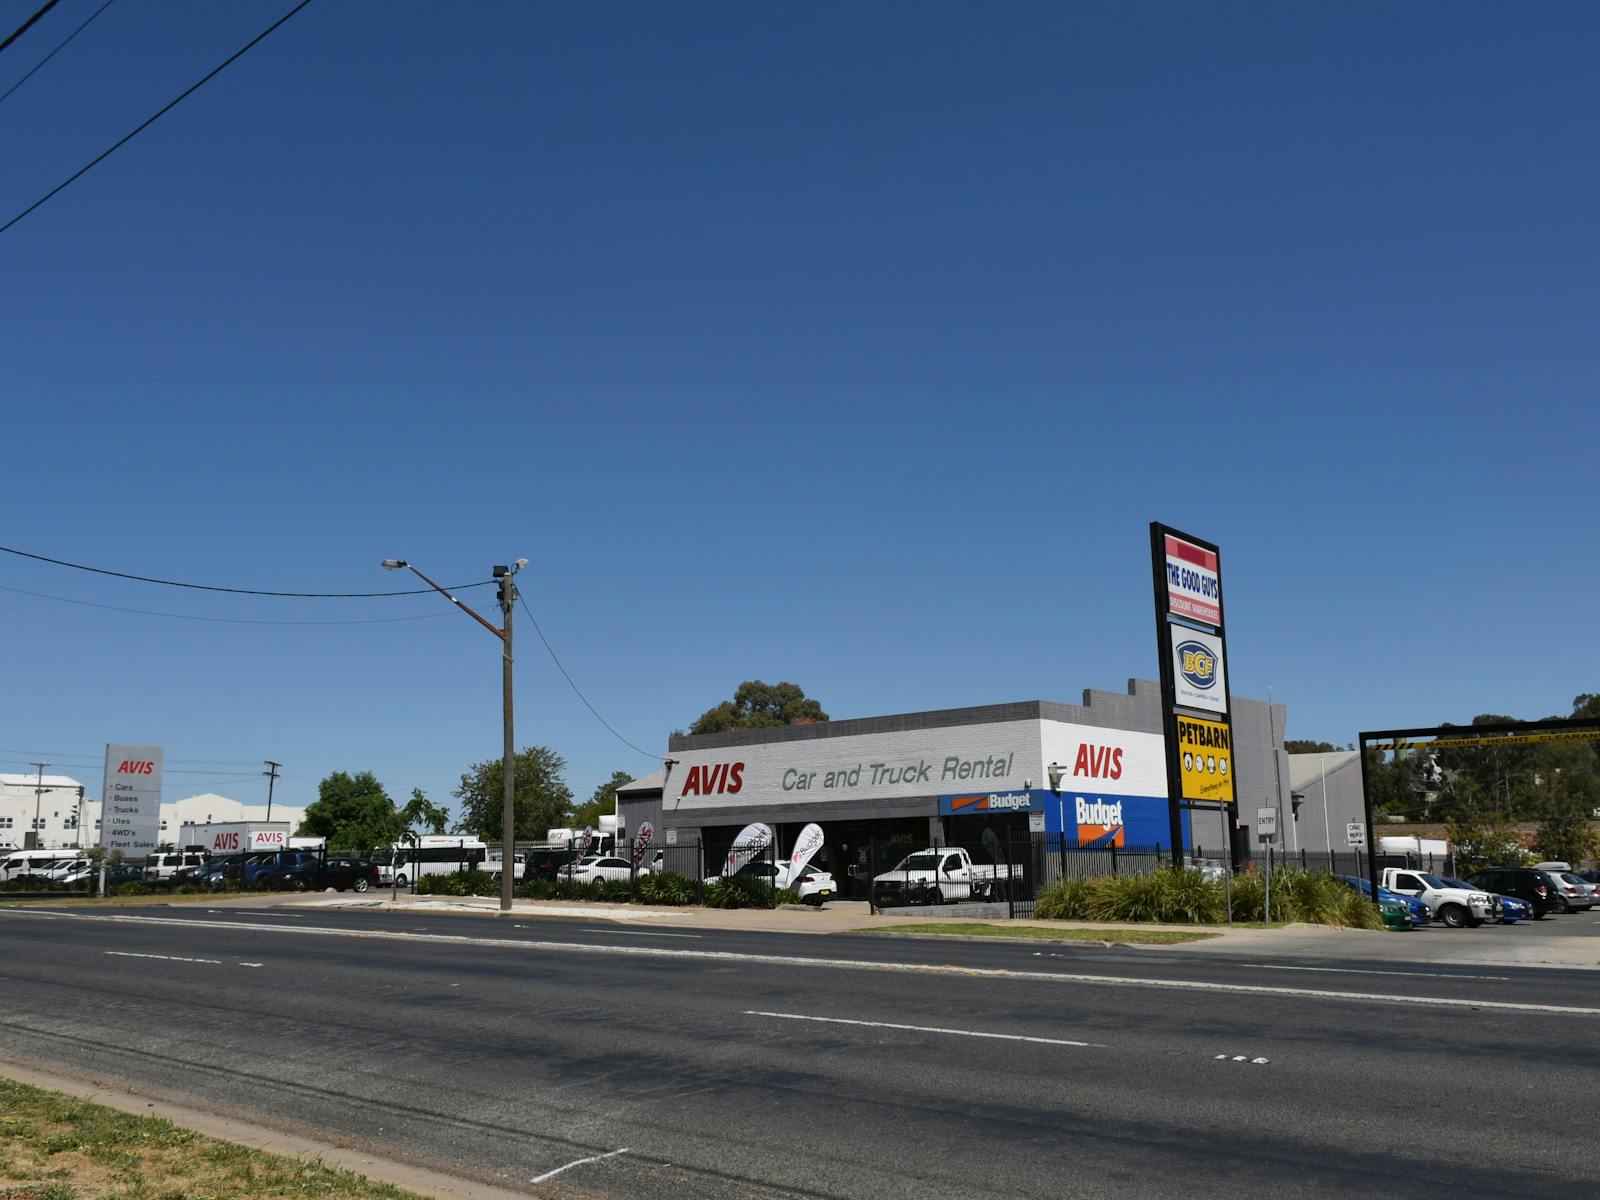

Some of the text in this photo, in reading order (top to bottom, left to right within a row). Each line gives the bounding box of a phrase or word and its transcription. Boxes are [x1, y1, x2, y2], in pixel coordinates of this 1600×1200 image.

[1167, 562, 1218, 600] THE GOOD GUYS
[1184, 651, 1213, 678] BCF
[1178, 720, 1229, 750] PETBARN
[1425, 739, 1480, 748] MAXIMUM
[1487, 736, 1528, 744] HEIGHT
[117, 760, 154, 775] AVIS
[1073, 743, 1123, 780] AVIS
[682, 752, 1014, 797] AVIS Car and Truck Rental
[115, 783, 133, 791] Cars
[114, 794, 138, 802] Buses
[988, 792, 1031, 811] Budget
[114, 806, 139, 814] Trucks
[1075, 796, 1123, 832] Budget
[112, 817, 130, 825] Utes
[1258, 816, 1274, 825] ENTRY
[111, 829, 136, 837] 4WD's
[256, 832, 283, 843] AVIS
[1349, 831, 1363, 839] WAY
[110, 840, 155, 848] Fleet Sales
[213, 832, 239, 850] AVIS
